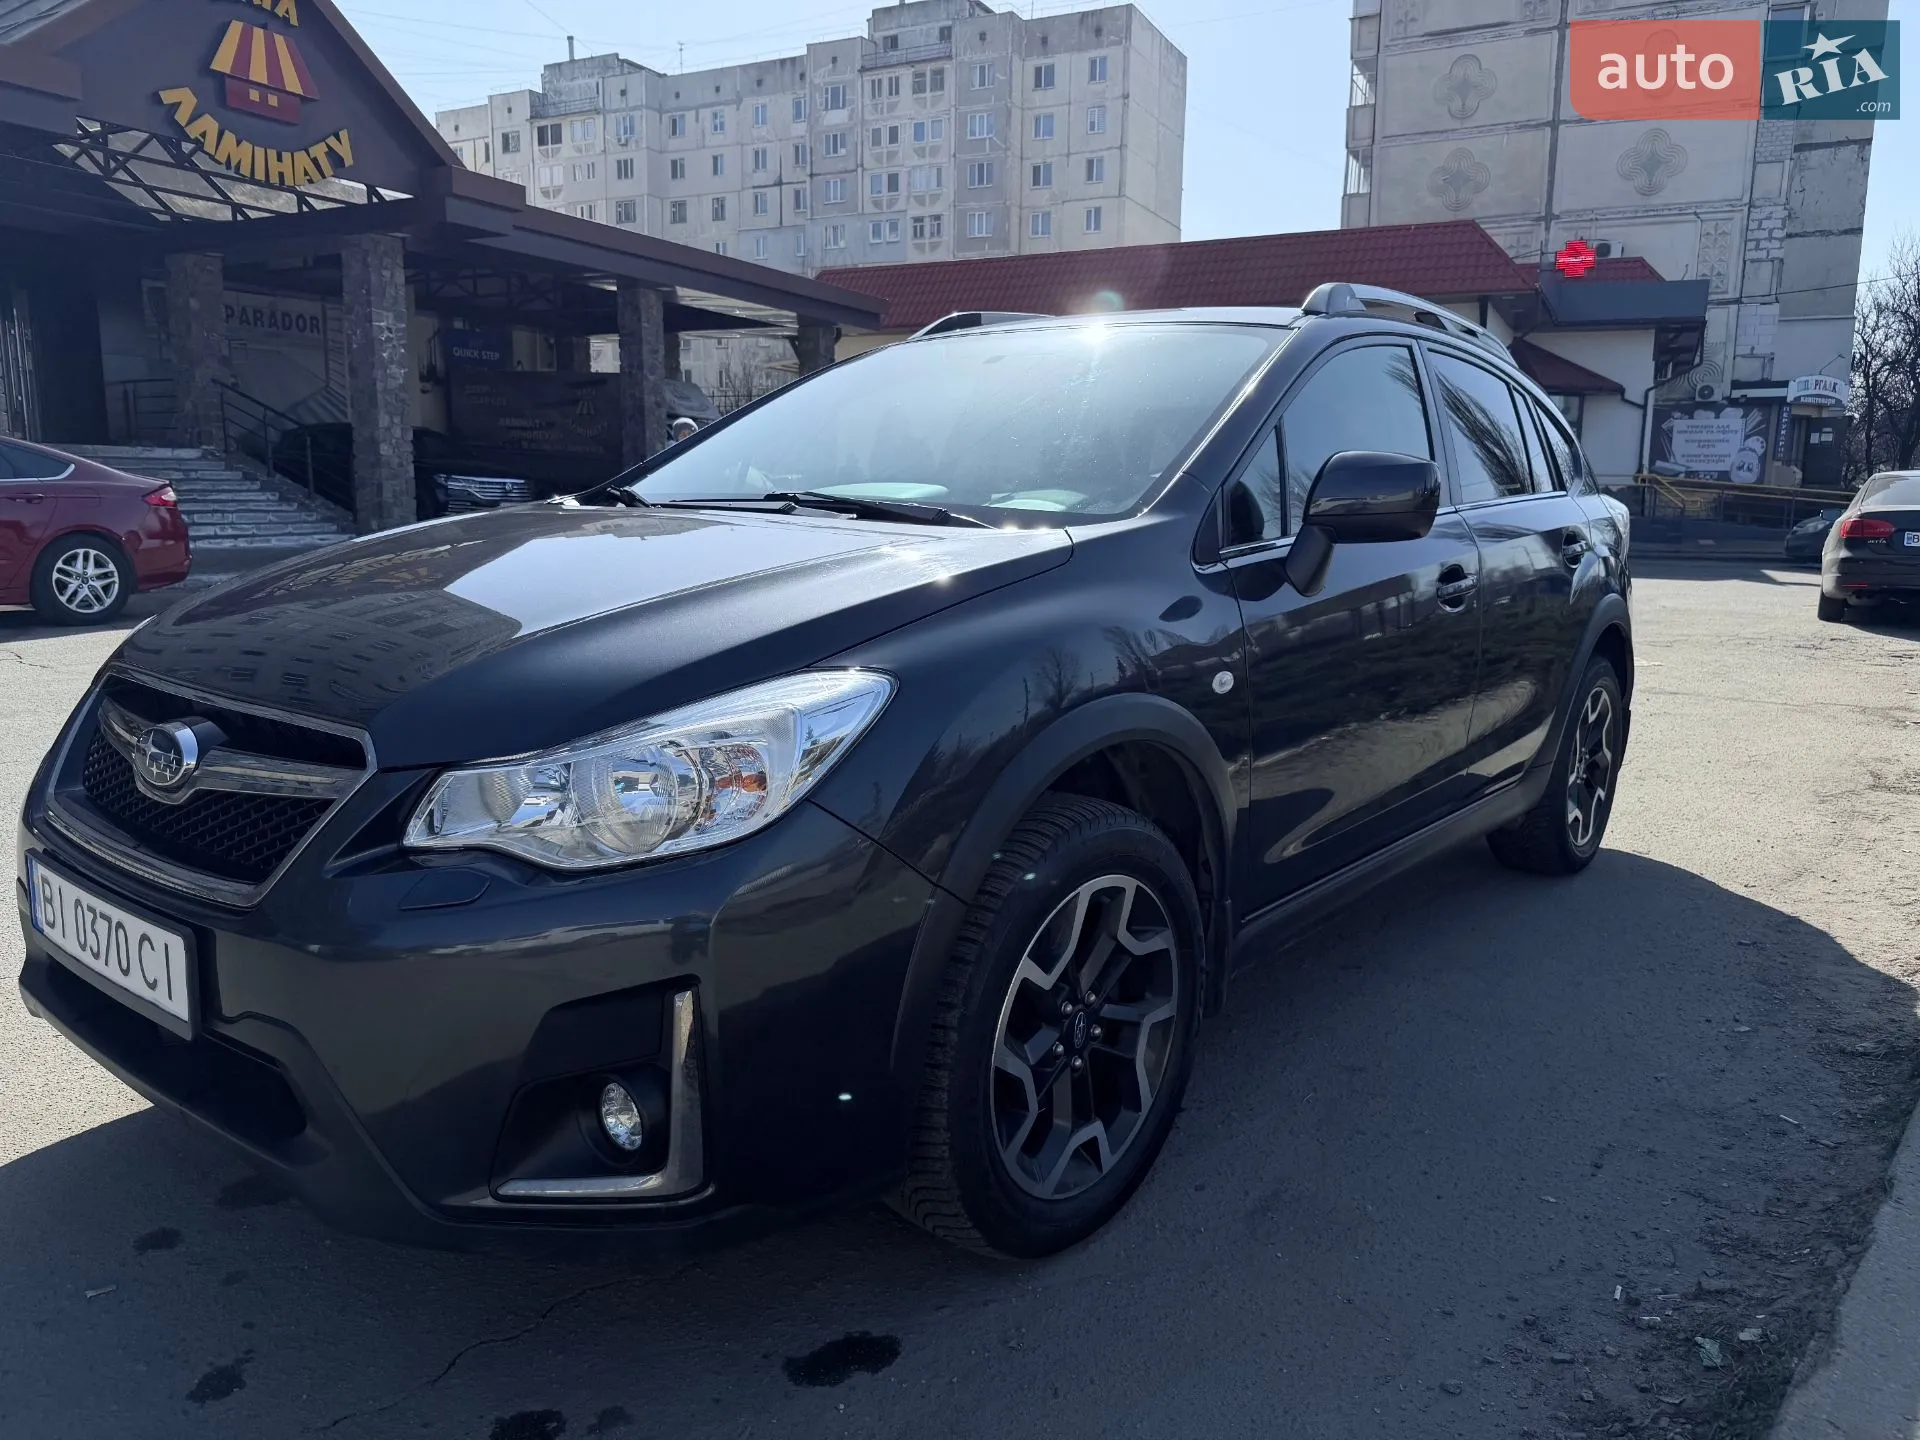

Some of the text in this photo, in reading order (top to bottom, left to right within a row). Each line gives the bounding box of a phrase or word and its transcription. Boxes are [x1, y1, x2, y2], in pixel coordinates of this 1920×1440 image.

[159, 86, 354, 186] ЛАМІНАТУ
[224, 303, 321, 335] PARADOR
[452, 346, 500, 361] QUICK STEP
[40, 873, 173, 1002] BI 0370 CI
